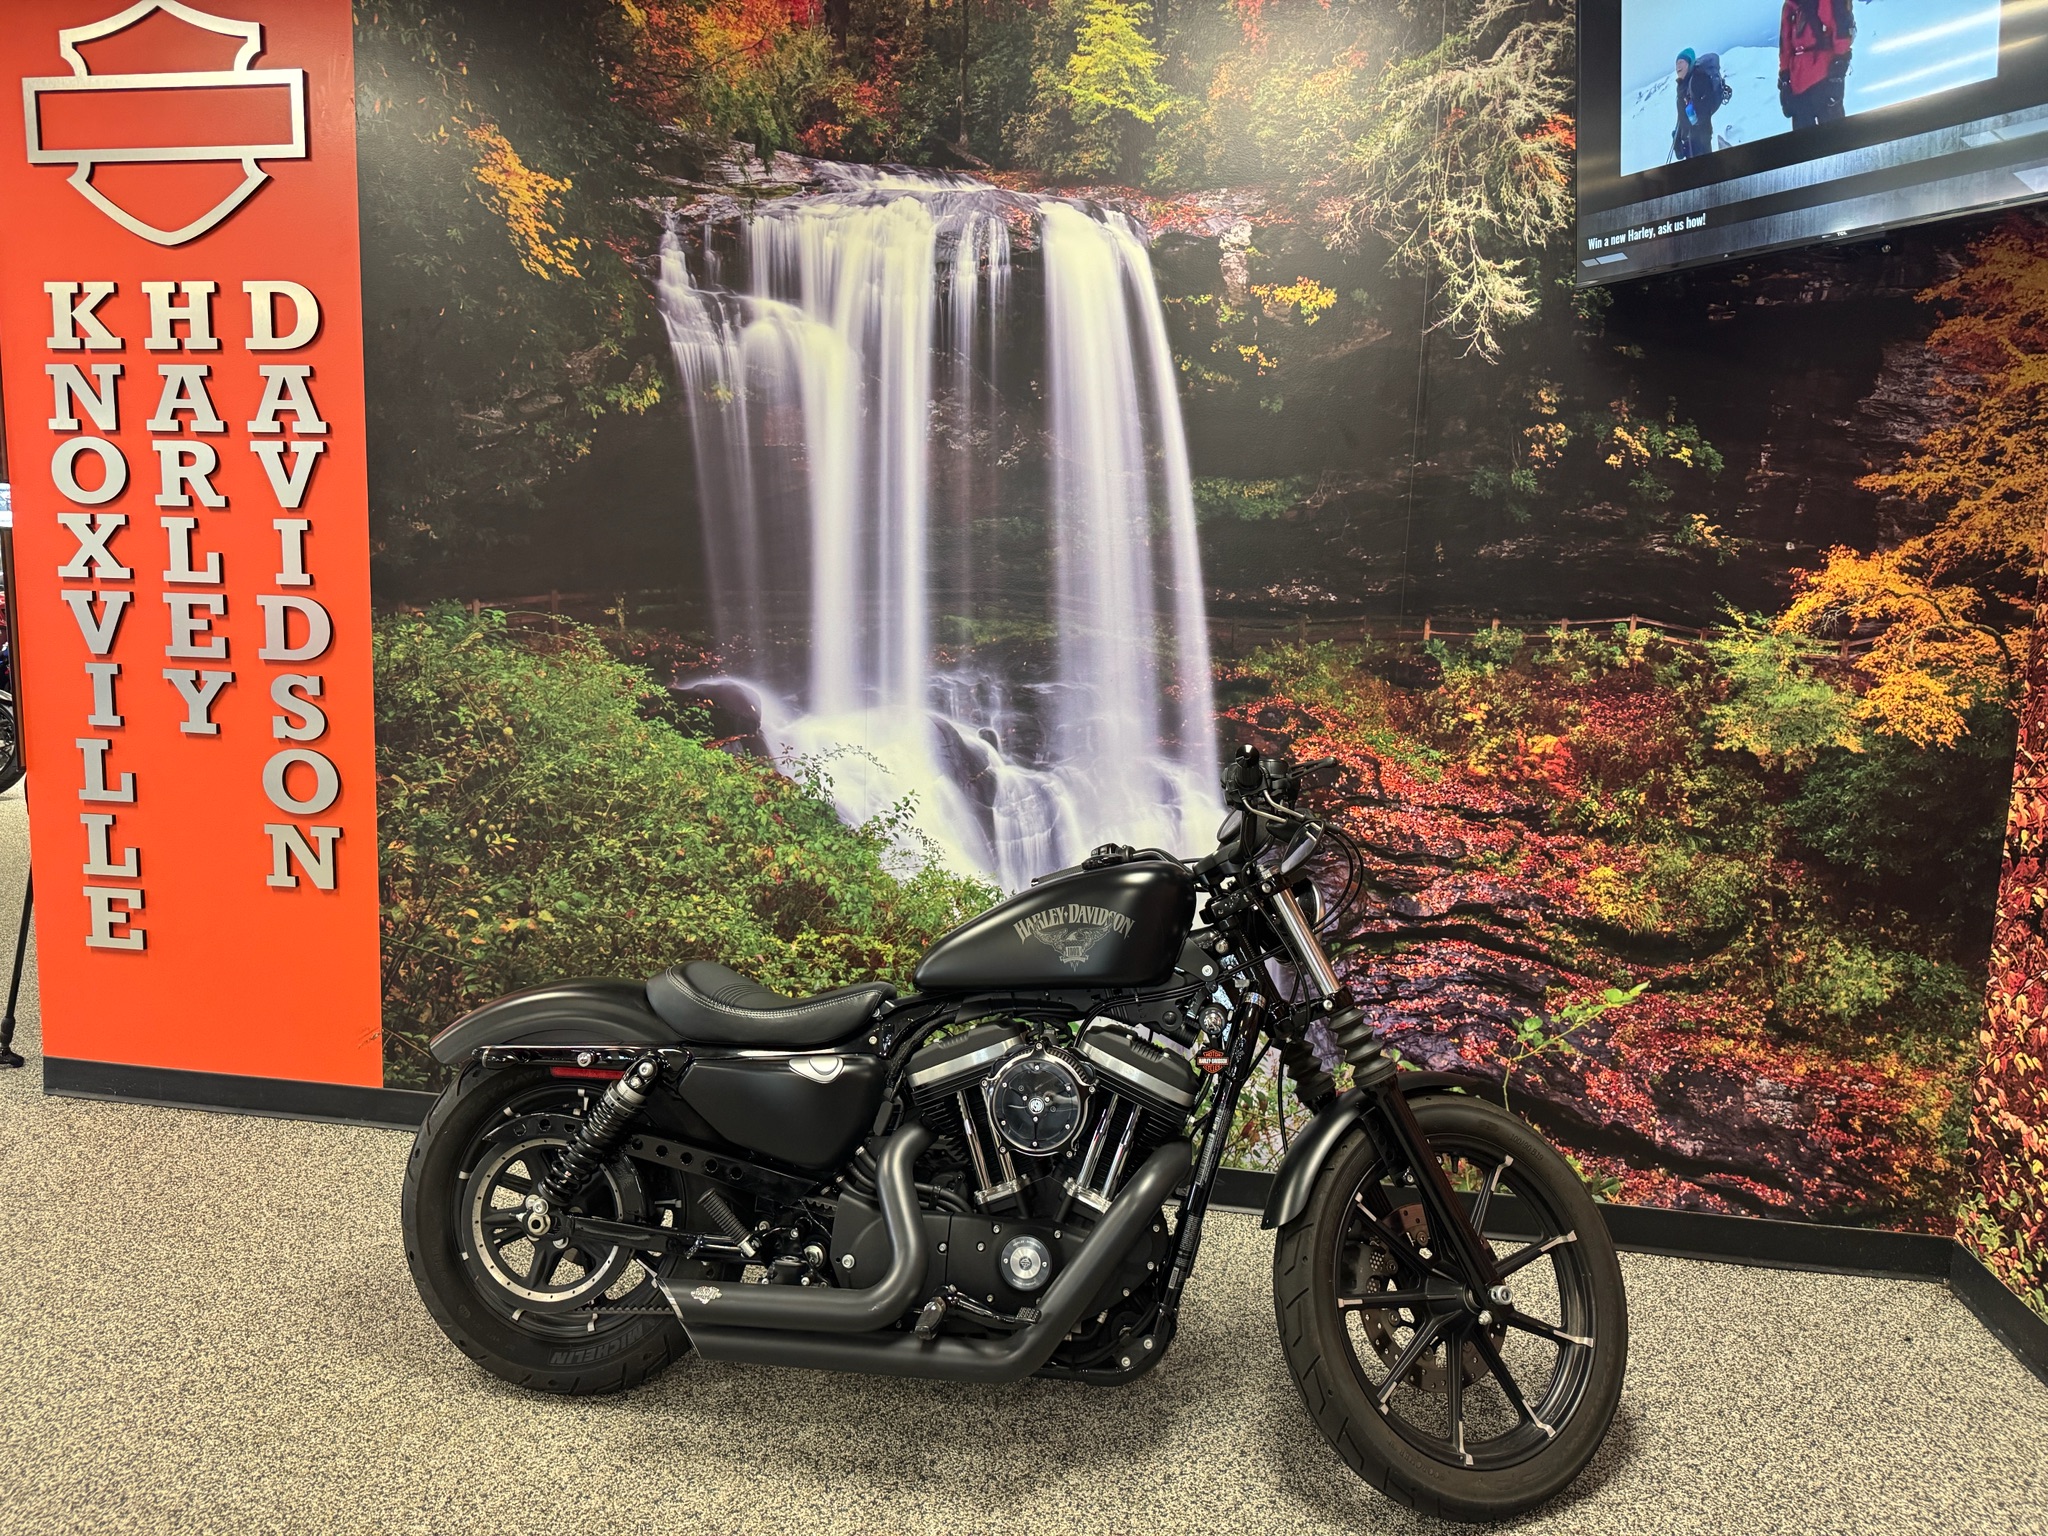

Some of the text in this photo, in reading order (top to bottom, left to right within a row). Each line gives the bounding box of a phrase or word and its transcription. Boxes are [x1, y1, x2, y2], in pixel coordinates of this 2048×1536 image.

[1588, 212, 1706, 250] Win a new Harley, ask us how!
[44, 281, 147, 951] KNOXVILLE
[142, 280, 235, 735] HARLEY
[243, 280, 342, 890] DAVIDSON
[550, 1323, 643, 1365] MICHELIN
